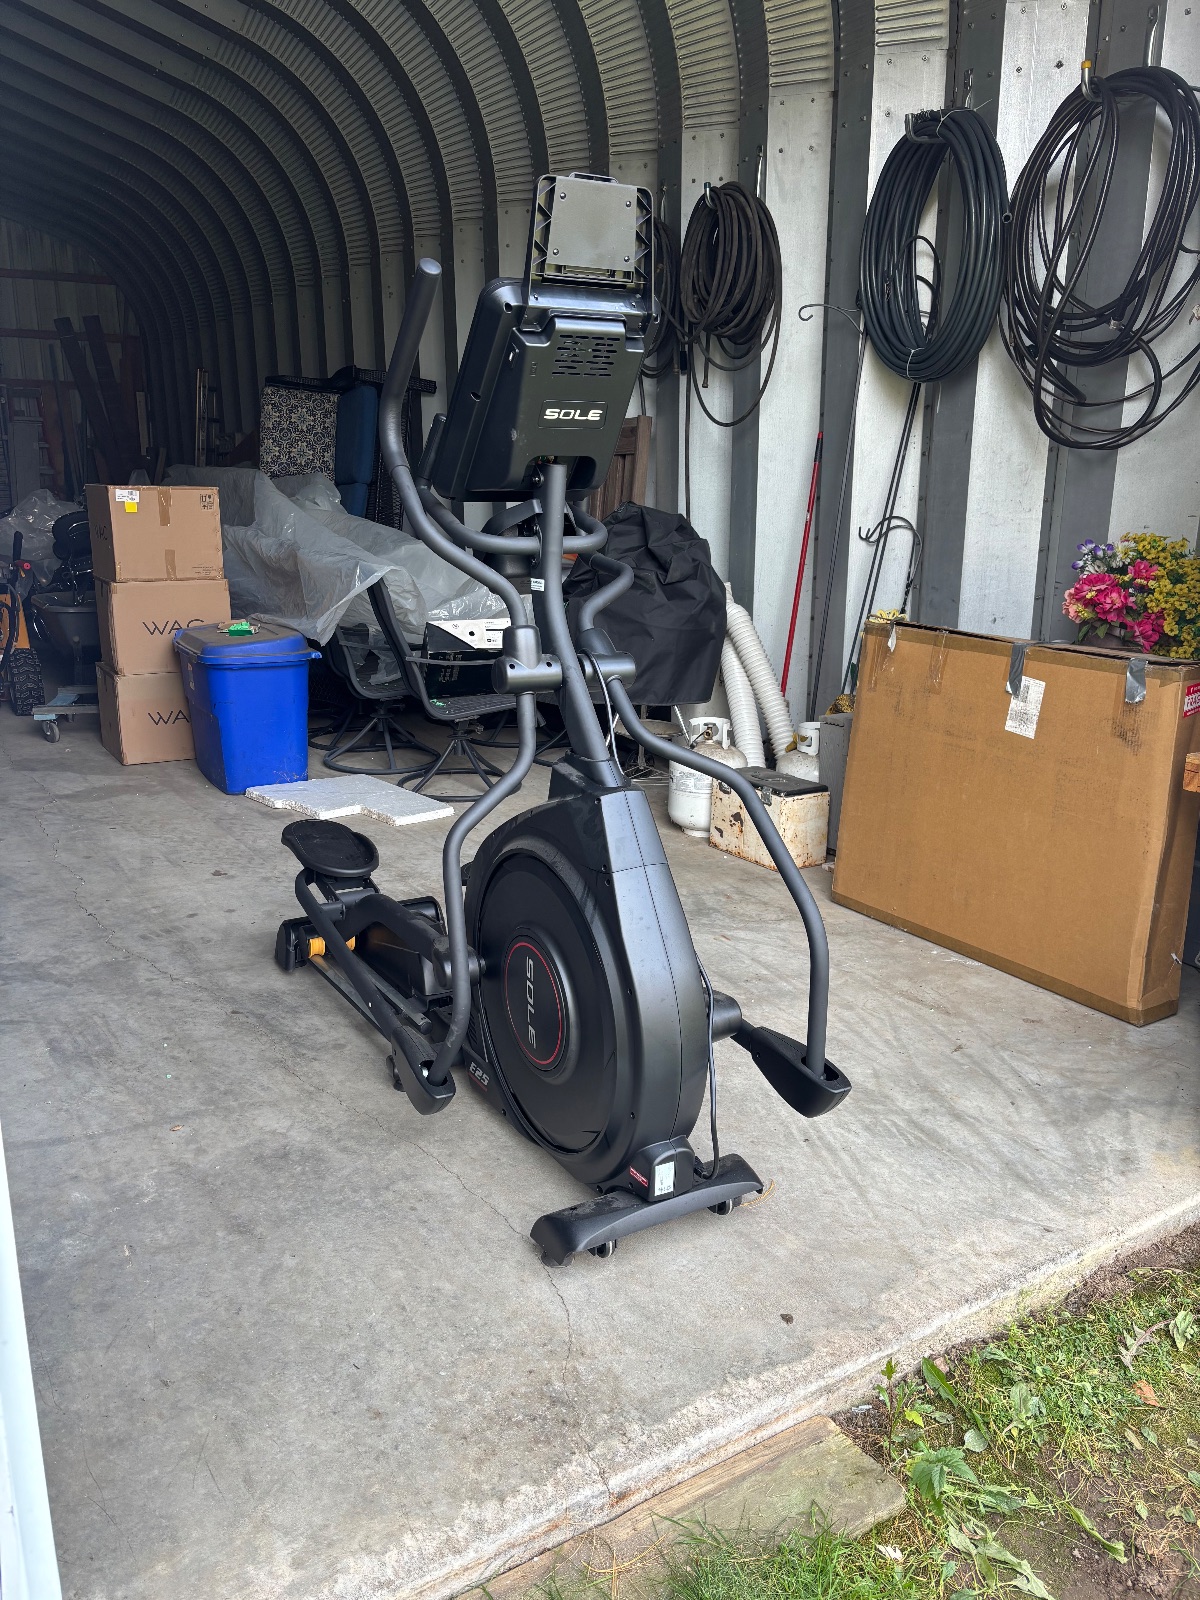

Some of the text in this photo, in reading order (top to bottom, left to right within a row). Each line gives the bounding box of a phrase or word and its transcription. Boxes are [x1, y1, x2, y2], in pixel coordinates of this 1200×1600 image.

[543, 408, 603, 421] SOLE
[526, 956, 536, 1049] SOLE
[469, 1061, 490, 1086] E25
